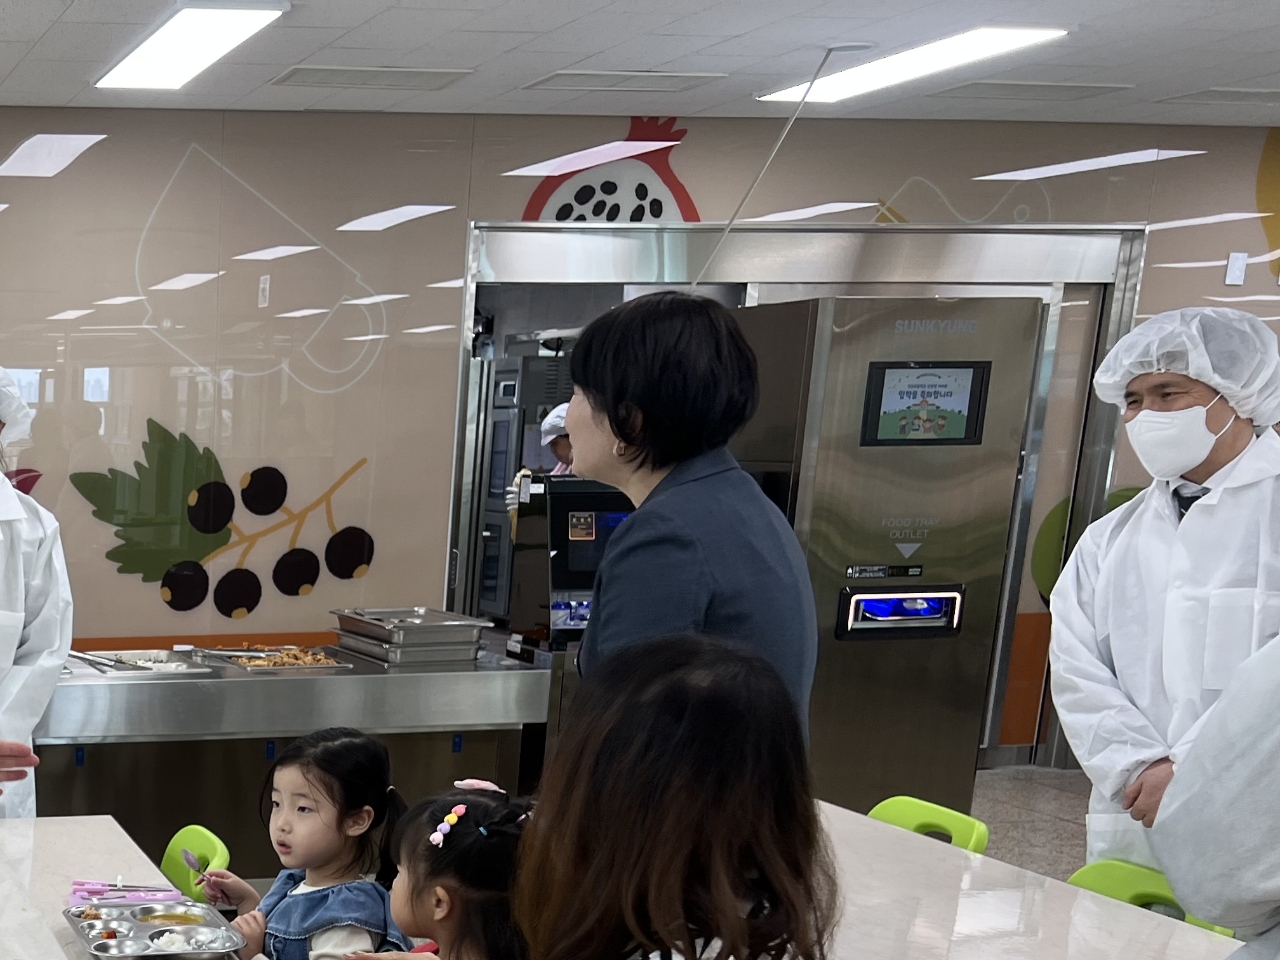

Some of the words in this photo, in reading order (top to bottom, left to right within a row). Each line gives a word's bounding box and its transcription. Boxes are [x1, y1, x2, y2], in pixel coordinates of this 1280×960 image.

[895, 319, 979, 335] SUNKYUNG
[881, 518, 911, 527] FOOD
[915, 517, 941, 527] TRAY
[889, 529, 930, 539] OUTLET
